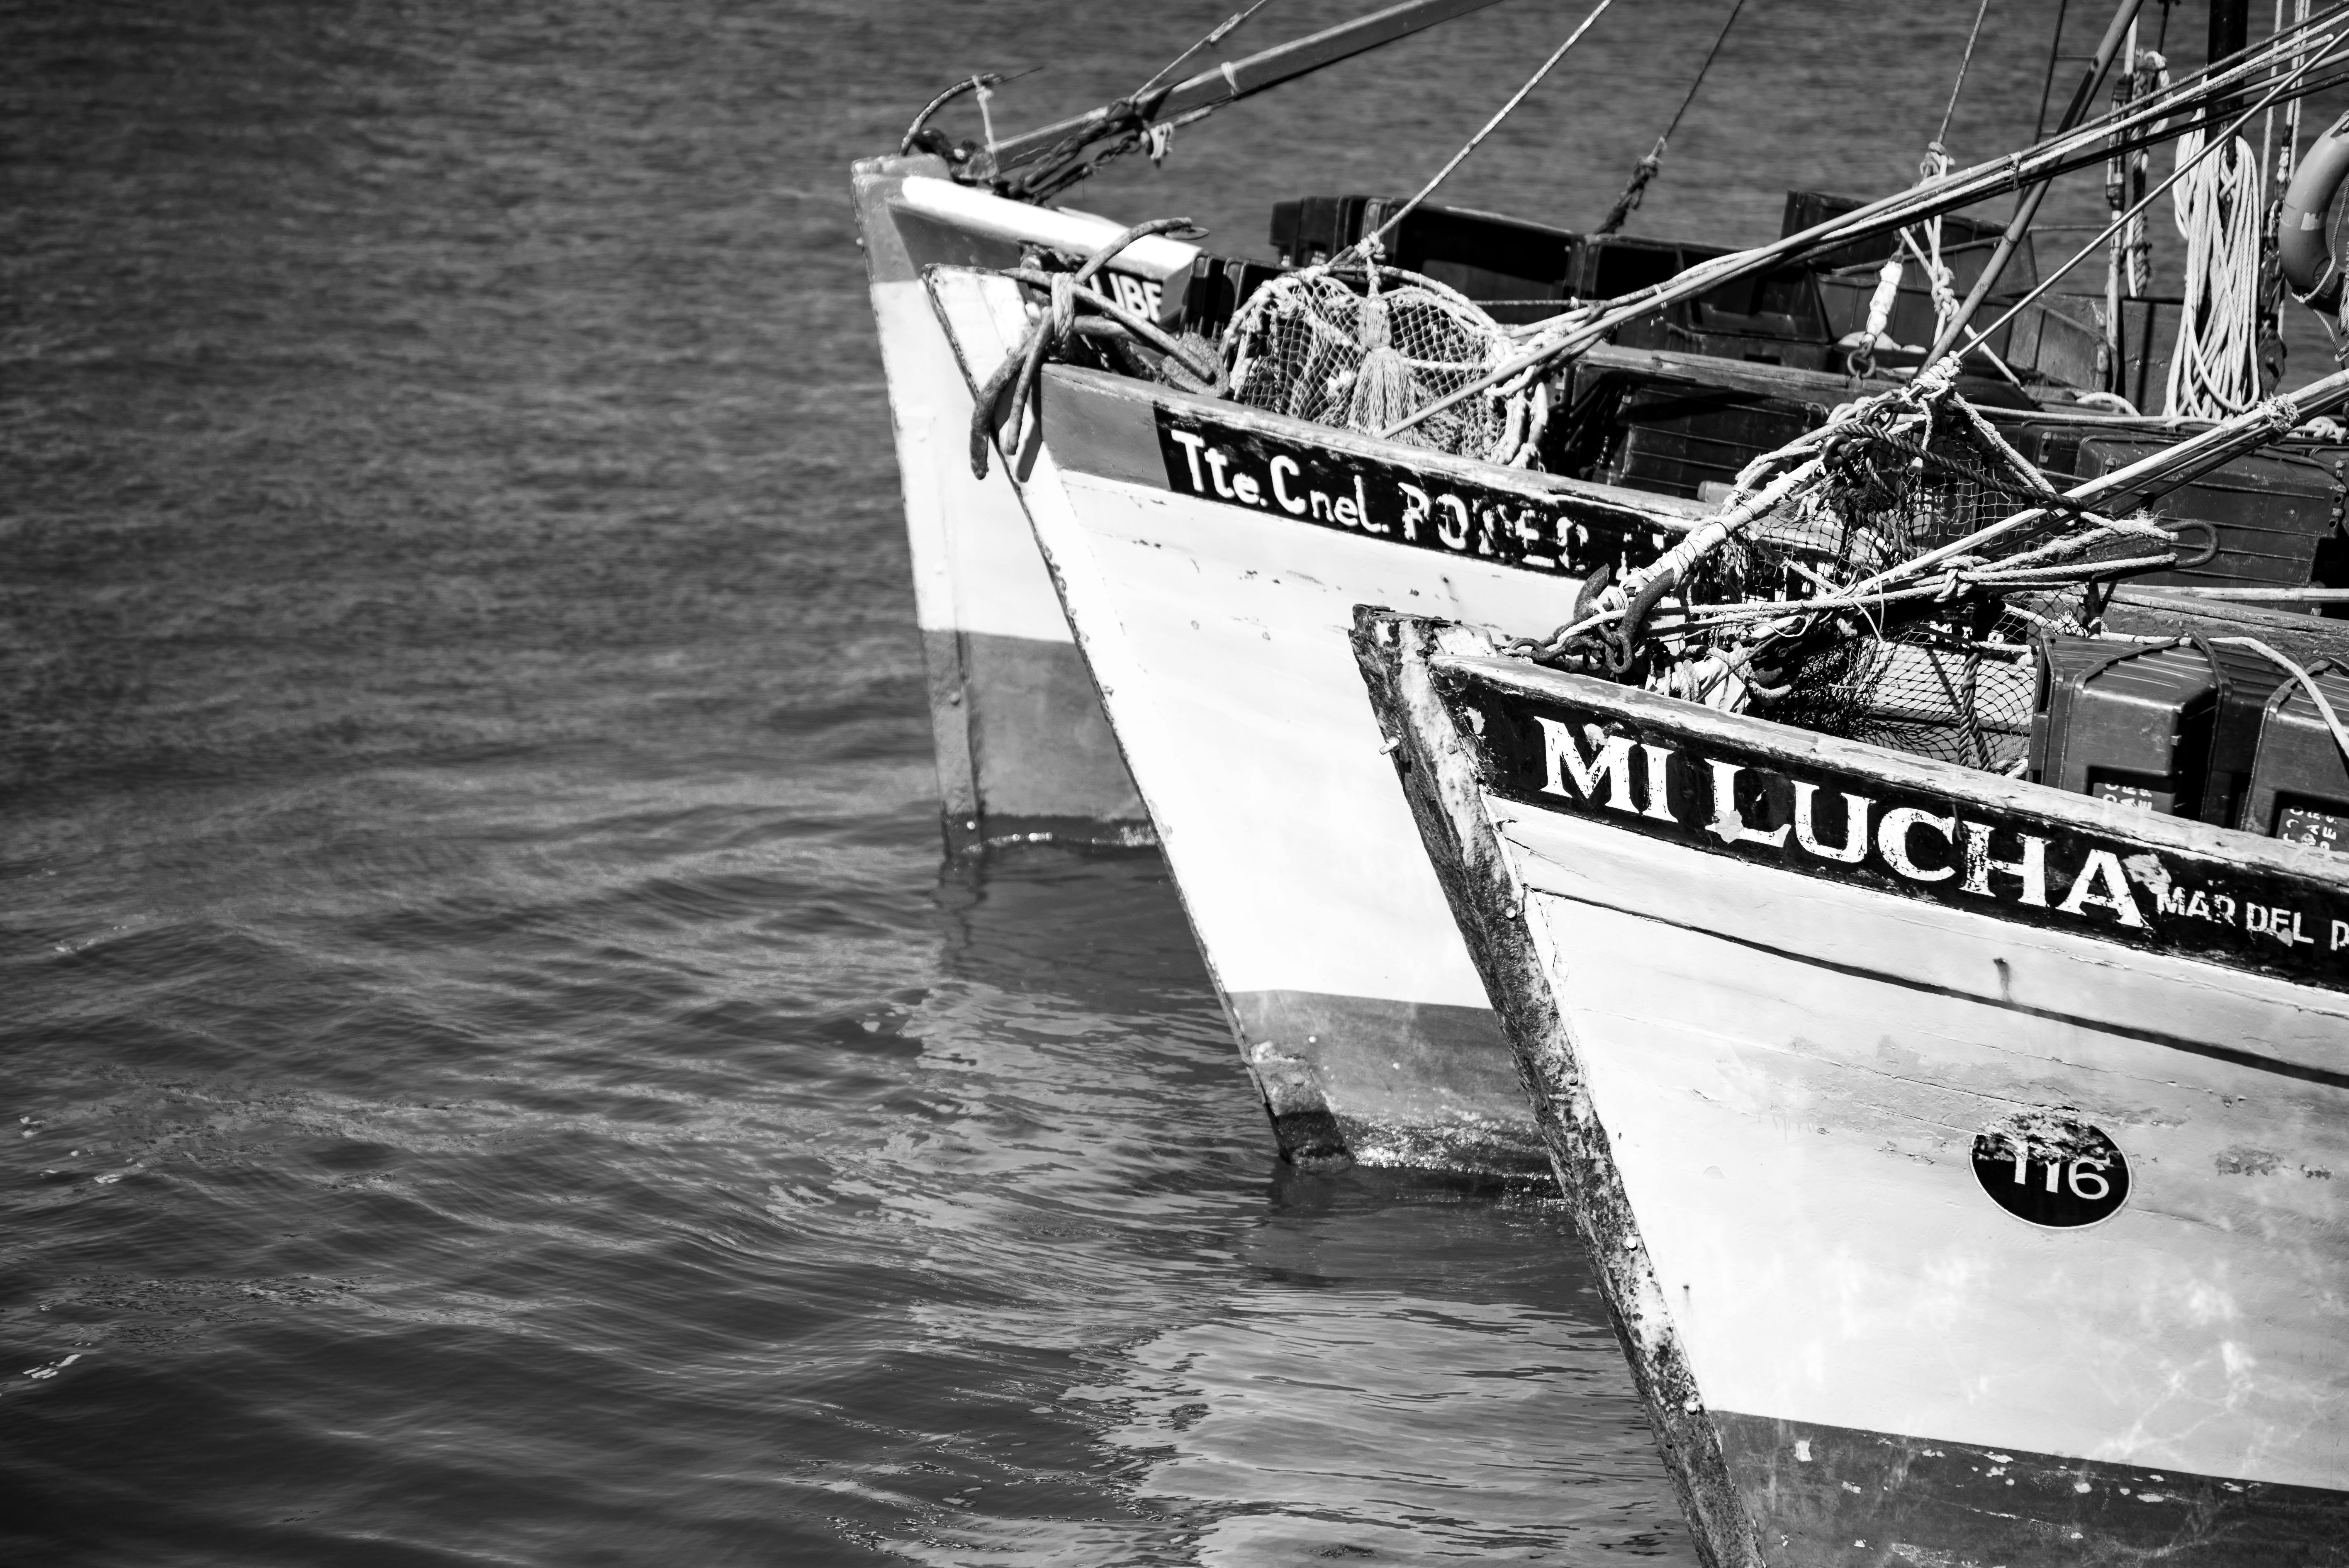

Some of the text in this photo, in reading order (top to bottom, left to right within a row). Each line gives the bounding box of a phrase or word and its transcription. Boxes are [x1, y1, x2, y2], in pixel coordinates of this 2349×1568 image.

[1171, 429, 1268, 507] Tte.
[1270, 455, 1390, 533] Cnel.
[1534, 716, 2154, 930] MI LUCHA
[2157, 886, 2236, 927] MAR
[2246, 901, 2315, 947] DEL
[2005, 1139, 2110, 1200] 116
